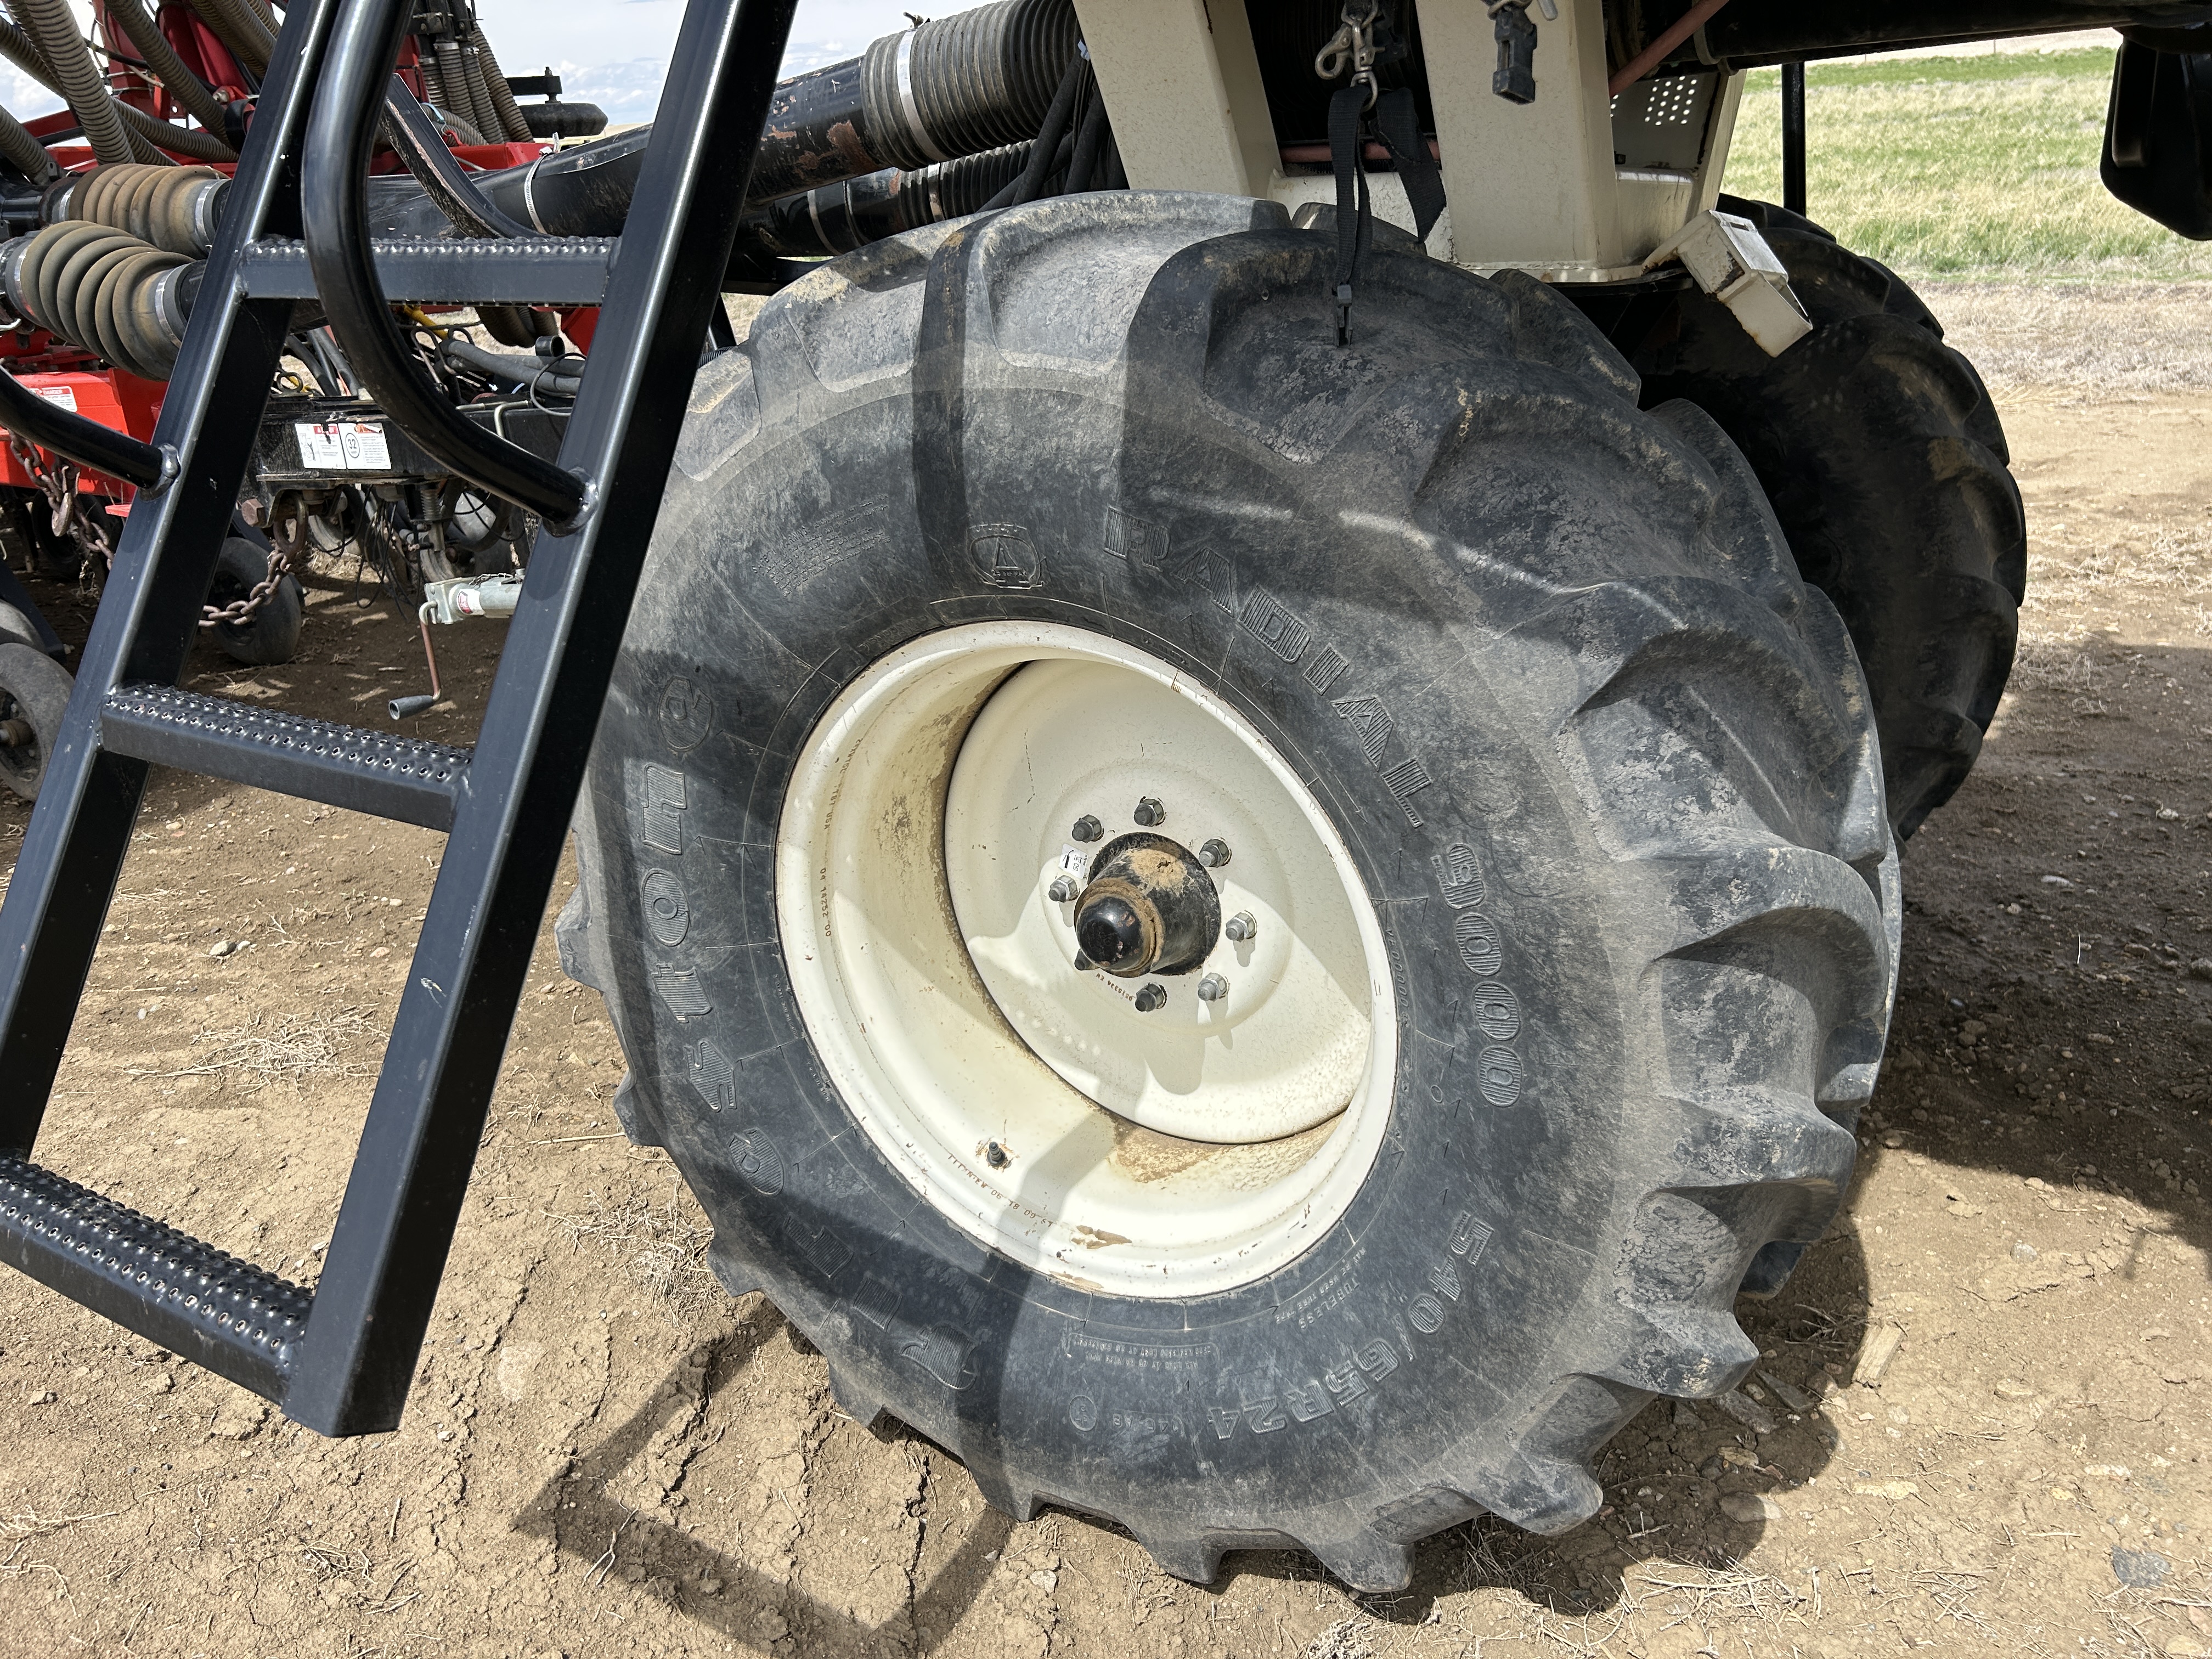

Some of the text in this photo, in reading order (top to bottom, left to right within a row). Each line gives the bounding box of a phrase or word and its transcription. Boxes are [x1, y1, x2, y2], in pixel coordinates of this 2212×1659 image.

[348, 438, 357, 449] 32
[1103, 505, 1523, 1108] RADIAL 9000
[1071, 862, 1080, 871] 50
[824, 924, 832, 936] 00
[641, 674, 980, 1391] Firestone
[1207, 1209, 1495, 1441] 540/65R24
[1296, 1277, 1360, 1330] TUBELESS
